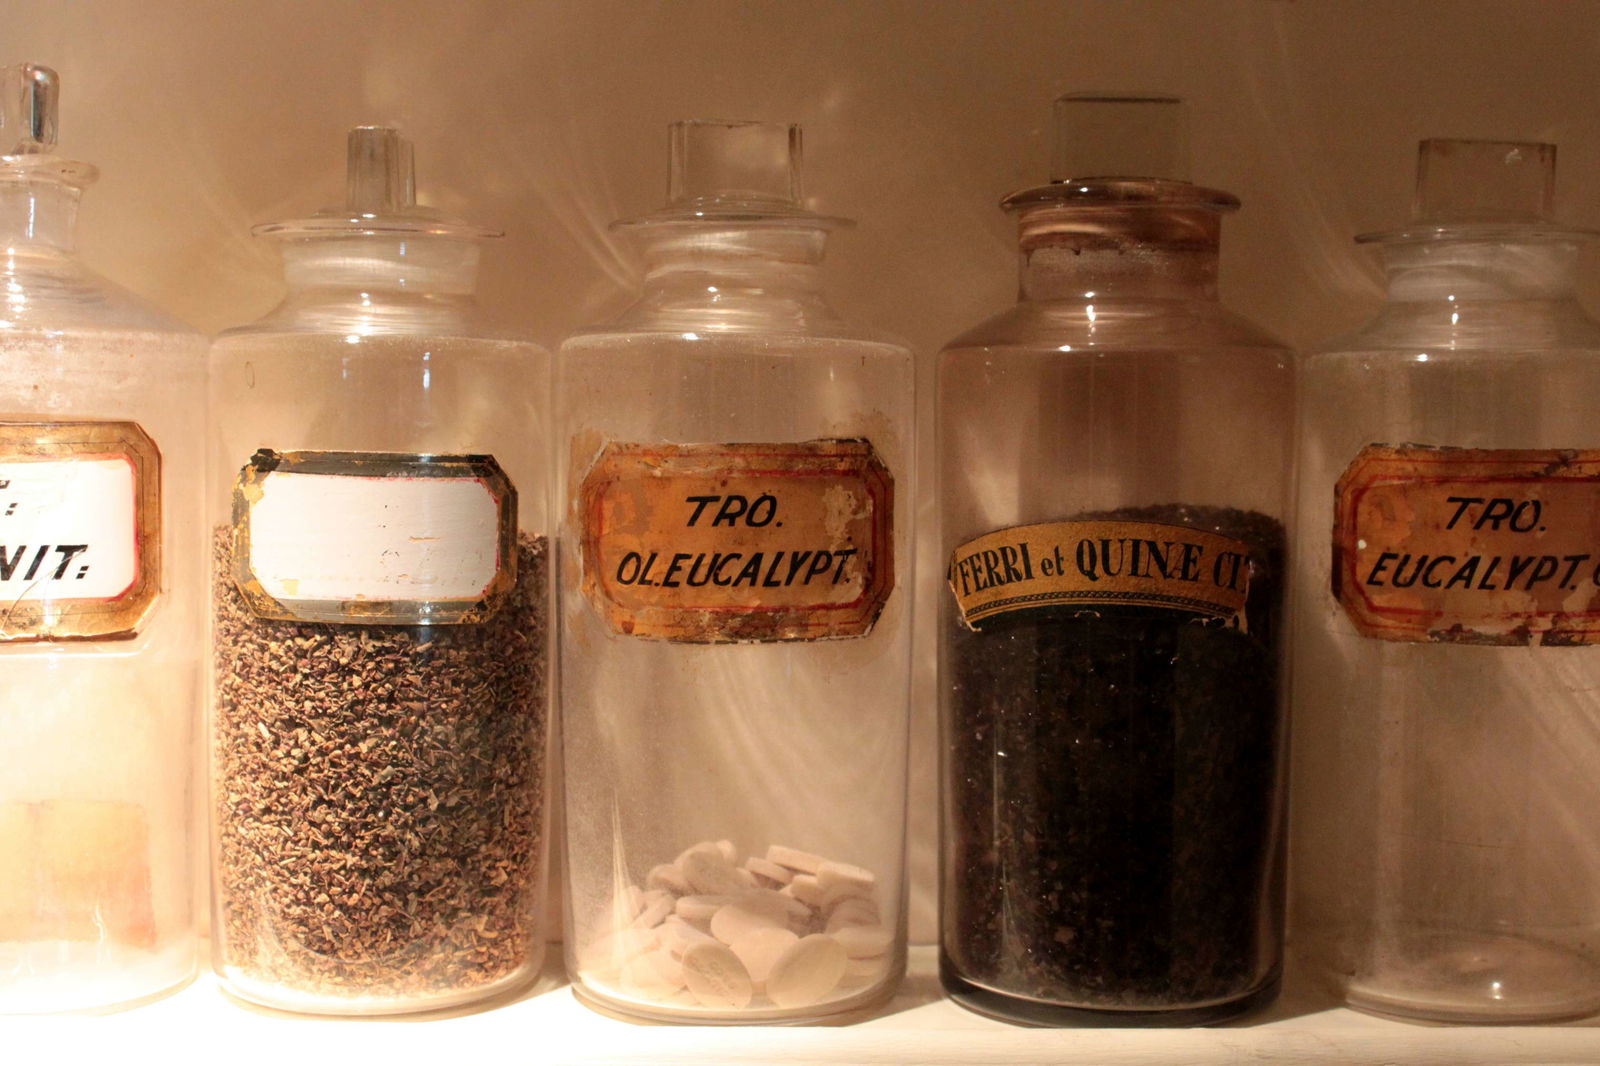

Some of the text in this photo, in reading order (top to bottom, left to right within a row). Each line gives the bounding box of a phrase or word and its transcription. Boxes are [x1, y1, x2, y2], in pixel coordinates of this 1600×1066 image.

[685, 494, 784, 528] TRO.
[1446, 496, 1547, 533] TRO.
[957, 542, 1036, 597] FERRI
[1040, 545, 1065, 577] et
[1366, 552, 1591, 591] EUCALYPT.
